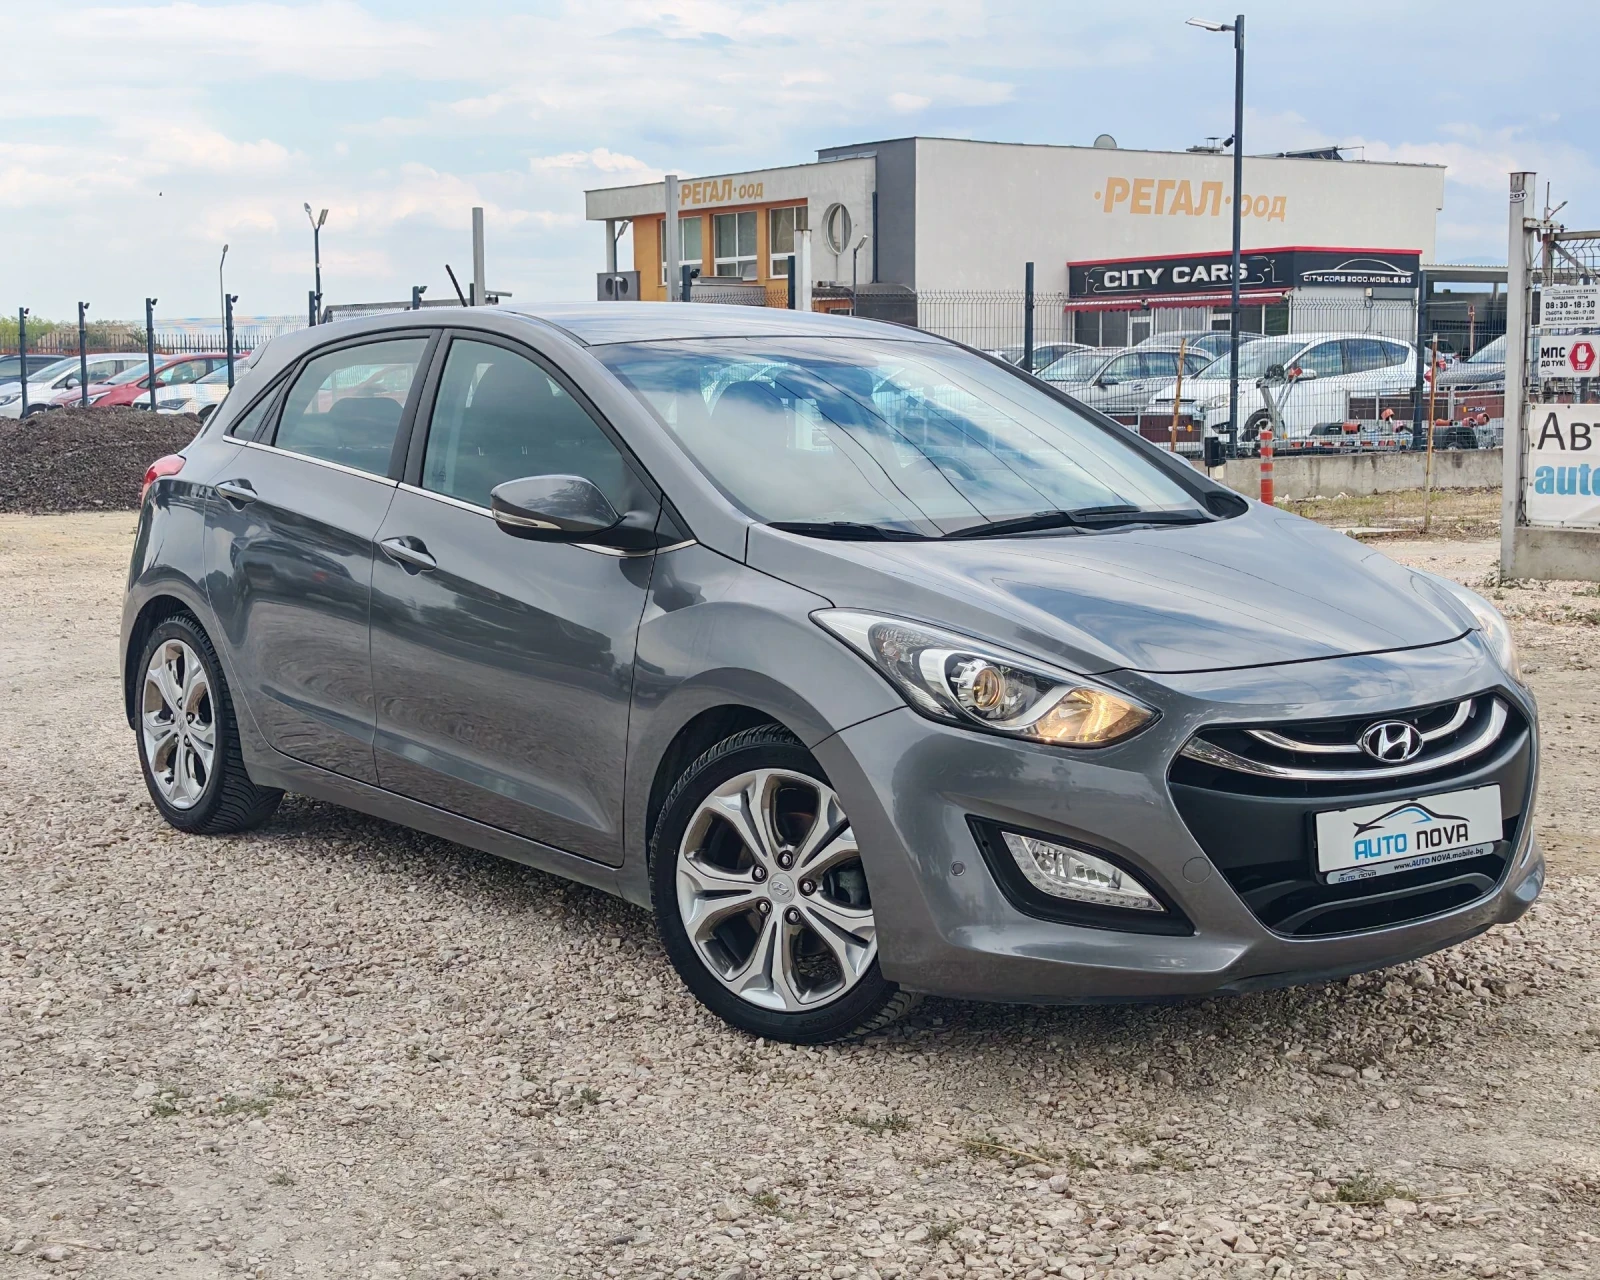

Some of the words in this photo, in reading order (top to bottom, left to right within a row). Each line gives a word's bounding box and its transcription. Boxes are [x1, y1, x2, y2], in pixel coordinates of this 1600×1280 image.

[681, 178, 733, 206] РЕГАЛ
[1103, 177, 1223, 216] РЕГАЛ
[1104, 267, 1164, 288] CITY
[1172, 263, 1248, 283] CARS
[1541, 346, 1566, 359] МПС
[1541, 360, 1550, 368] ДО
[1354, 833, 1407, 860] AUTO
[1416, 823, 1469, 850] NOVA
